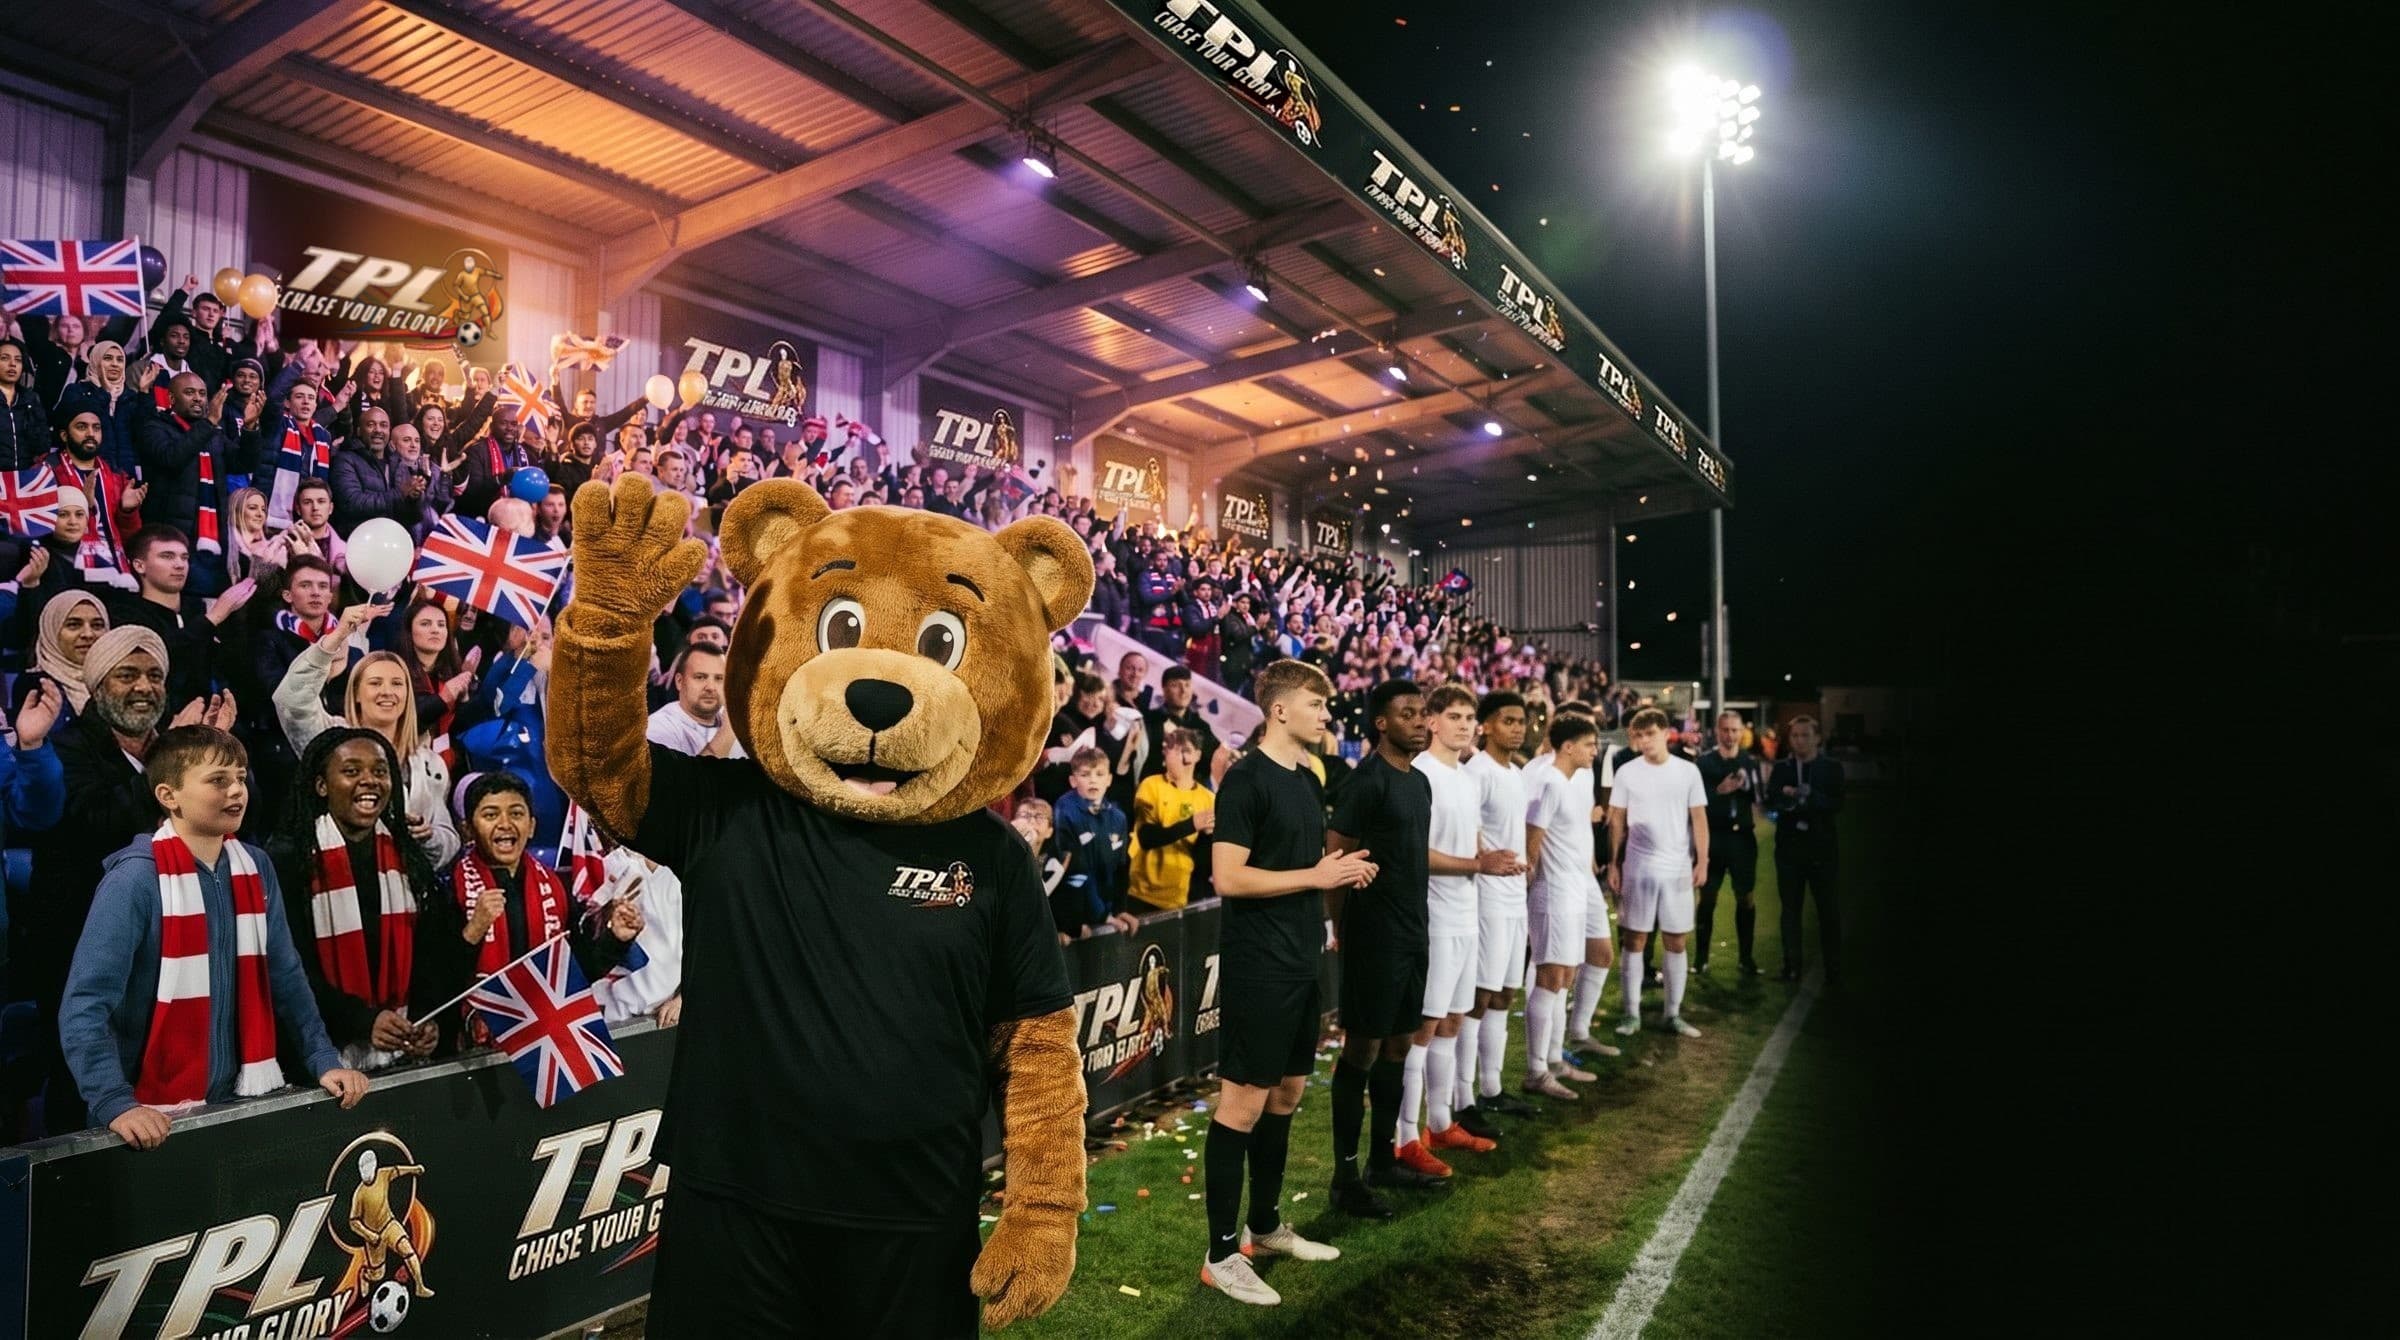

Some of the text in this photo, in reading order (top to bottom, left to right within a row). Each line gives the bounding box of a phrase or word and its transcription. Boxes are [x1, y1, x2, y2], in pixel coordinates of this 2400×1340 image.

[1154, 11, 1282, 100] CHASE YOUR GLORY
[1371, 150, 1441, 234] TPL
[287, 246, 448, 311] TPL
[1501, 264, 1547, 331] TPL
[280, 291, 450, 336] CHASE YOUR GLORY
[683, 337, 772, 401] TPL
[1599, 353, 1631, 402] TPL
[932, 409, 995, 457] TPL
[1103, 460, 1150, 499] TPL
[891, 866, 952, 892] TPL
[1073, 976, 1143, 1049] TPL
[78, 1193, 338, 1340] TPL
[508, 1223, 586, 1281] CHASE
[590, 1204, 645, 1253] YOUR
